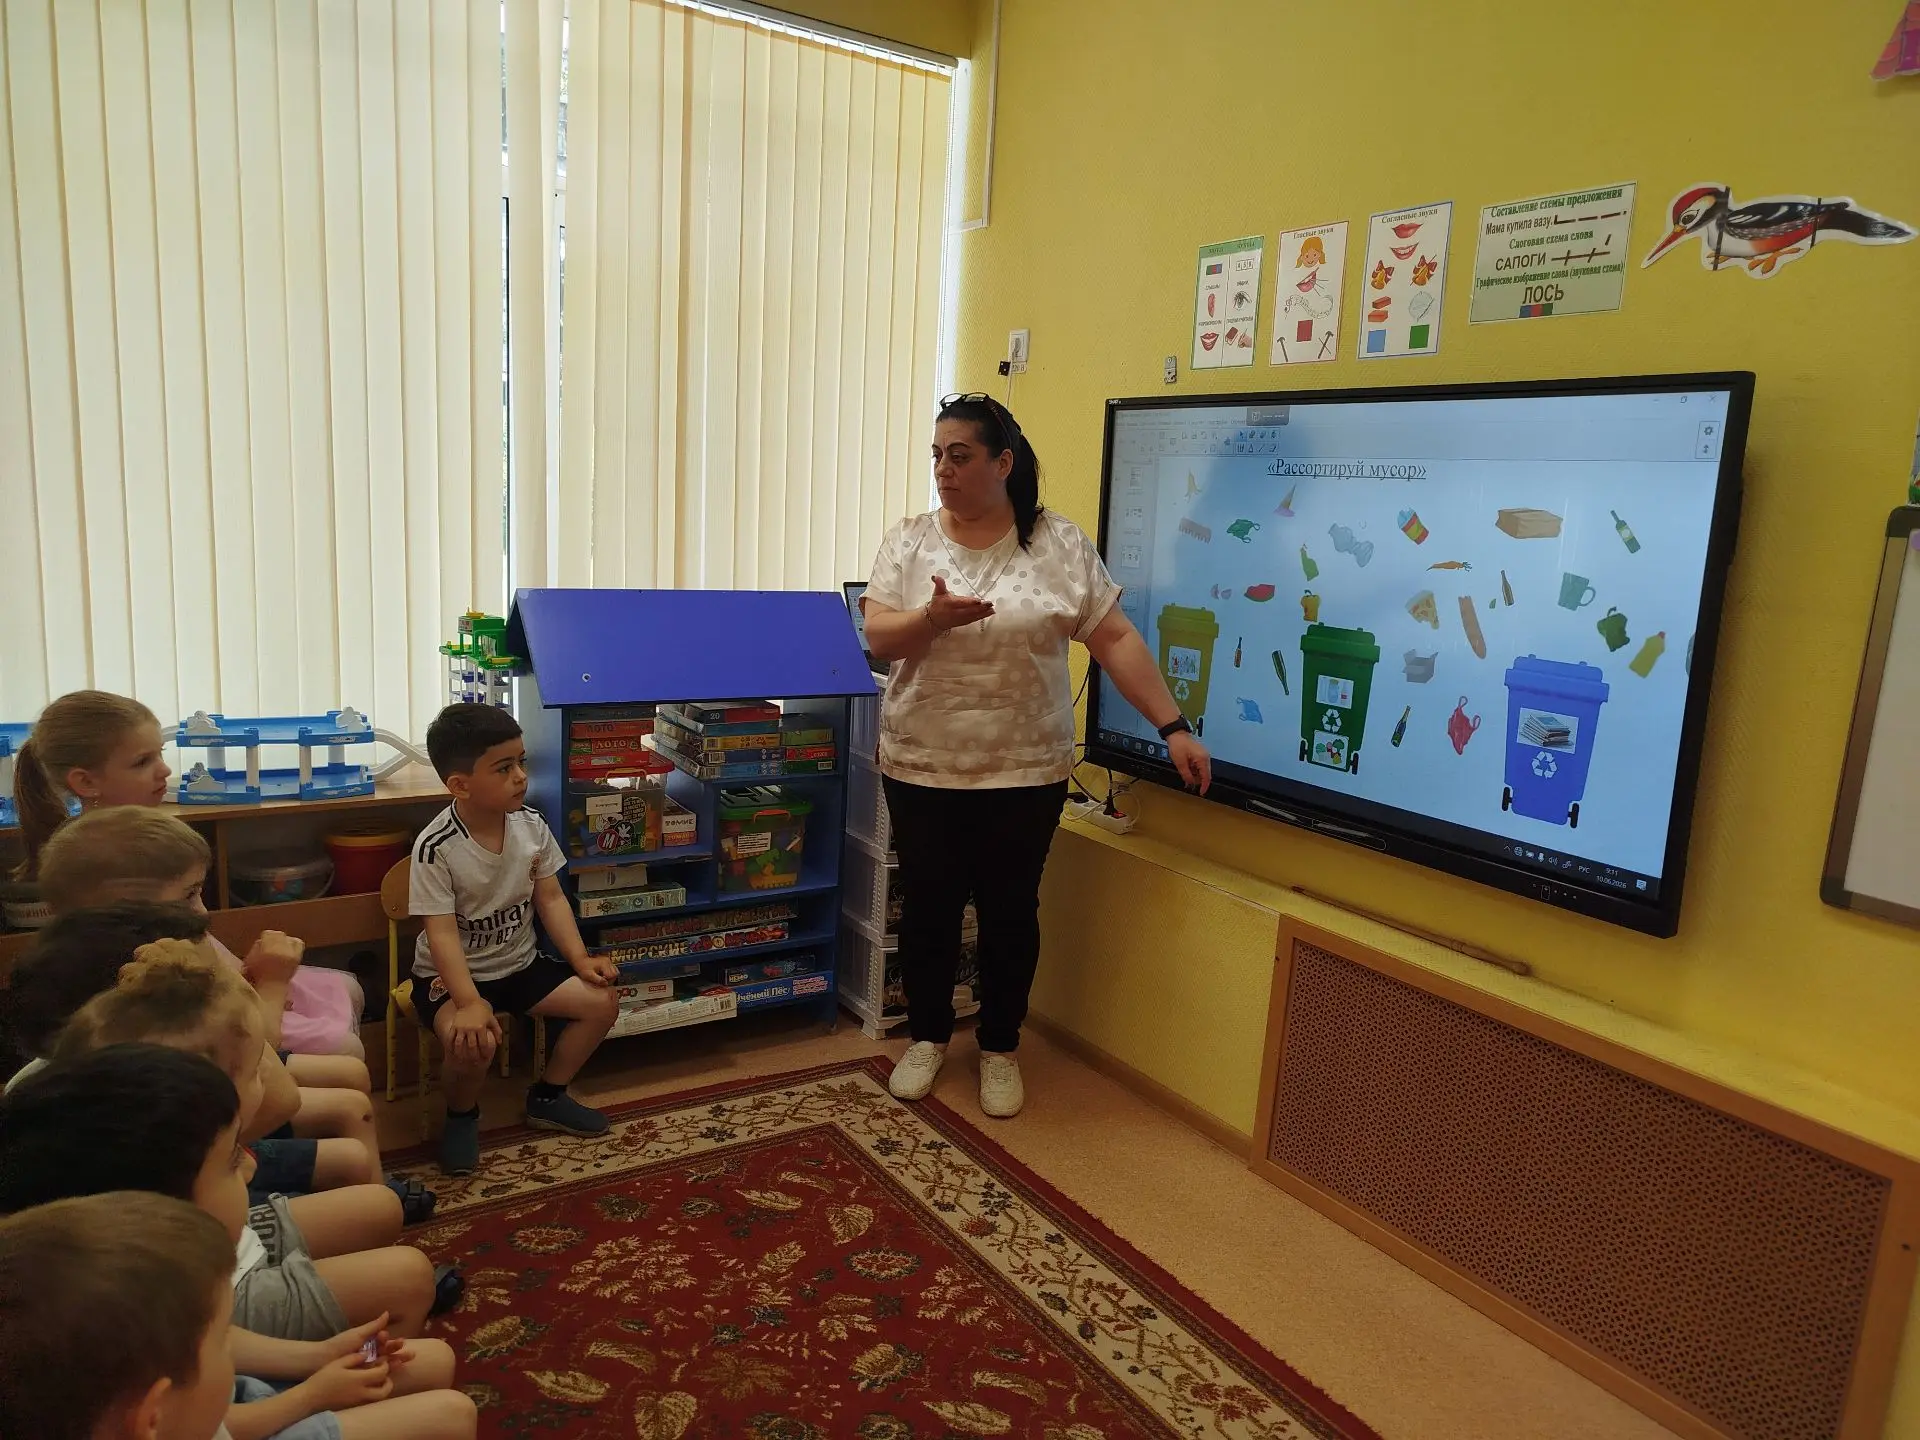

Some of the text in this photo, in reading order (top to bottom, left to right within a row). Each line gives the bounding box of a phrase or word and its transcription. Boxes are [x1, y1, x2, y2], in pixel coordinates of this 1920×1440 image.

[1491, 188, 1623, 218] Составление схемы предложения
[1381, 208, 1438, 224] Согласные звуки
[1486, 216, 1553, 235] Мама купила вазу.
[1509, 230, 1594, 250] Слоговая схема слова
[1495, 252, 1546, 271] САПОГИ
[1551, 268, 1569, 279] слова
[1523, 283, 1564, 304] ЛОСЬ
[1267, 459, 1427, 481] «Рассортируй мусор»
[468, 932, 493, 948] FLY
